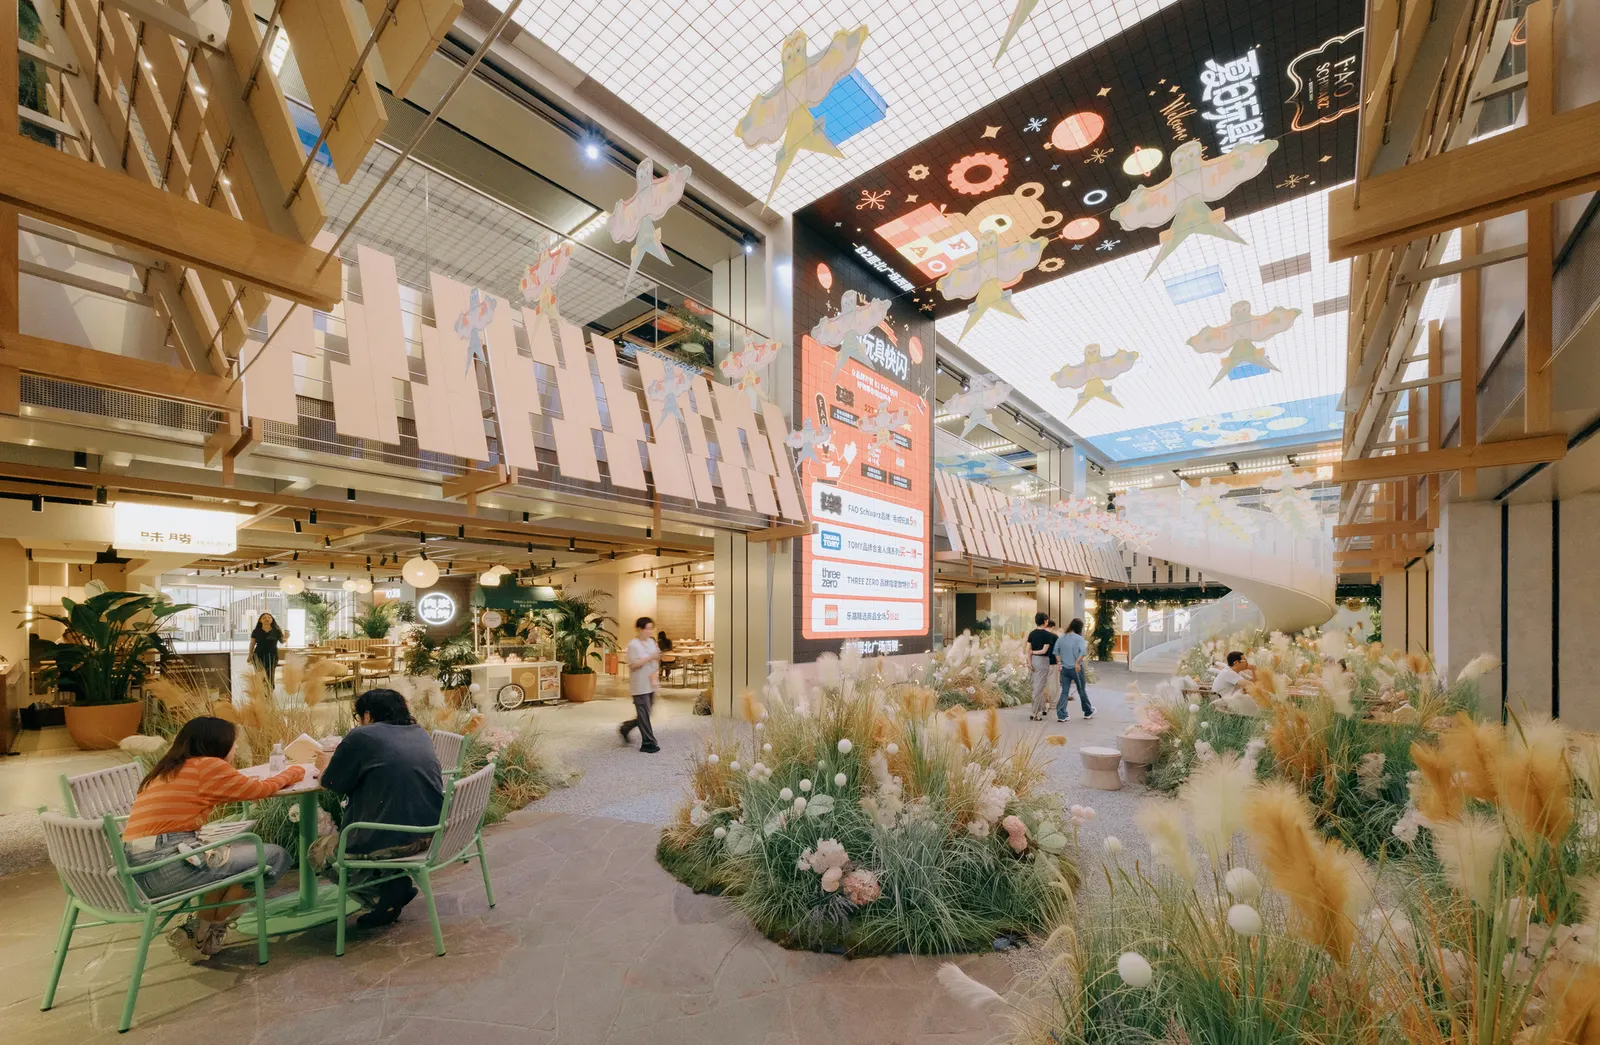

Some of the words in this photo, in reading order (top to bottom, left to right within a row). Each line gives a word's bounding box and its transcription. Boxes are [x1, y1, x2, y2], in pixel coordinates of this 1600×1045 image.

[1159, 92, 1197, 141] Welcome
[948, 238, 971, 251] F
[909, 246, 931, 259] A
[927, 259, 946, 272] O
[823, 539, 839, 548] TOMY
[822, 567, 841, 580] three
[822, 579, 838, 588] zero
[847, 576, 865, 585] THREE
[865, 578, 879, 586] ZERO
